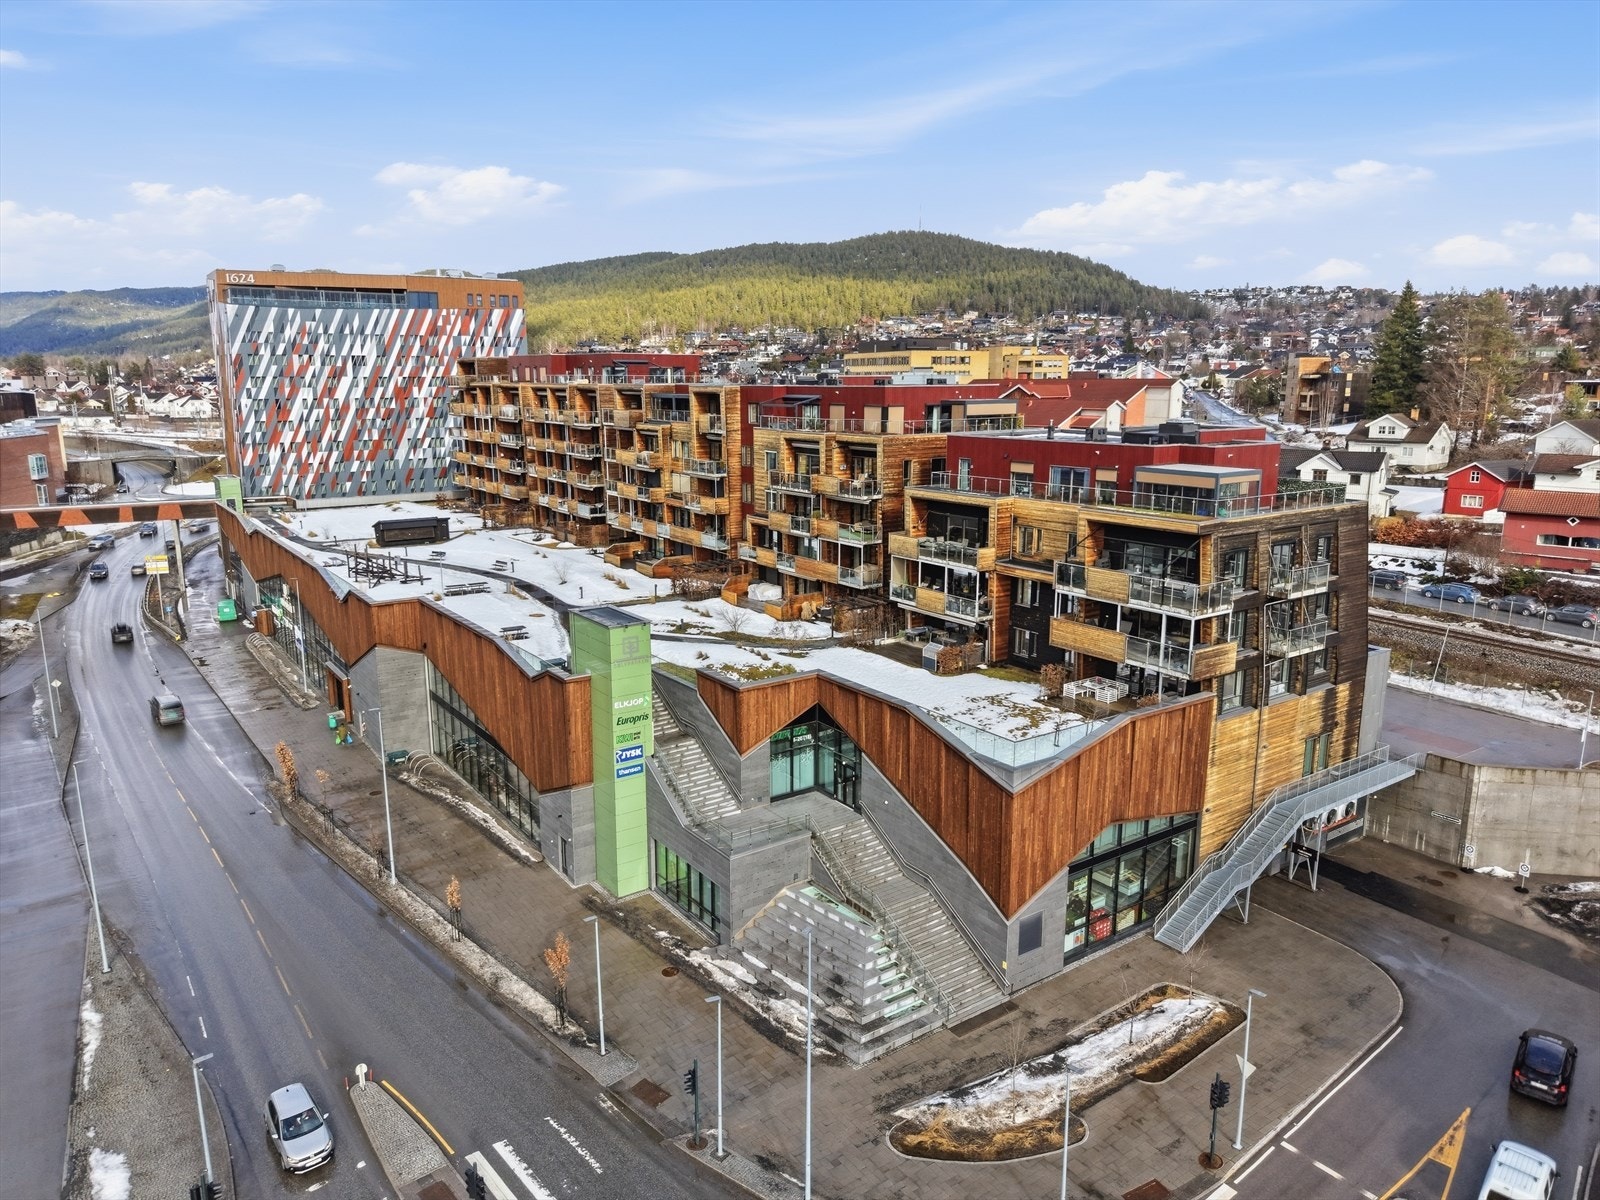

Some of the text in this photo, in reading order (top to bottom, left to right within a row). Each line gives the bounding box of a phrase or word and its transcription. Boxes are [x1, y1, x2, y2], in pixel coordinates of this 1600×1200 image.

[225, 273, 255, 283] 1624
[616, 712, 649, 726] Europris
[616, 733, 633, 744] KIWI
[621, 747, 642, 759] JYSK
